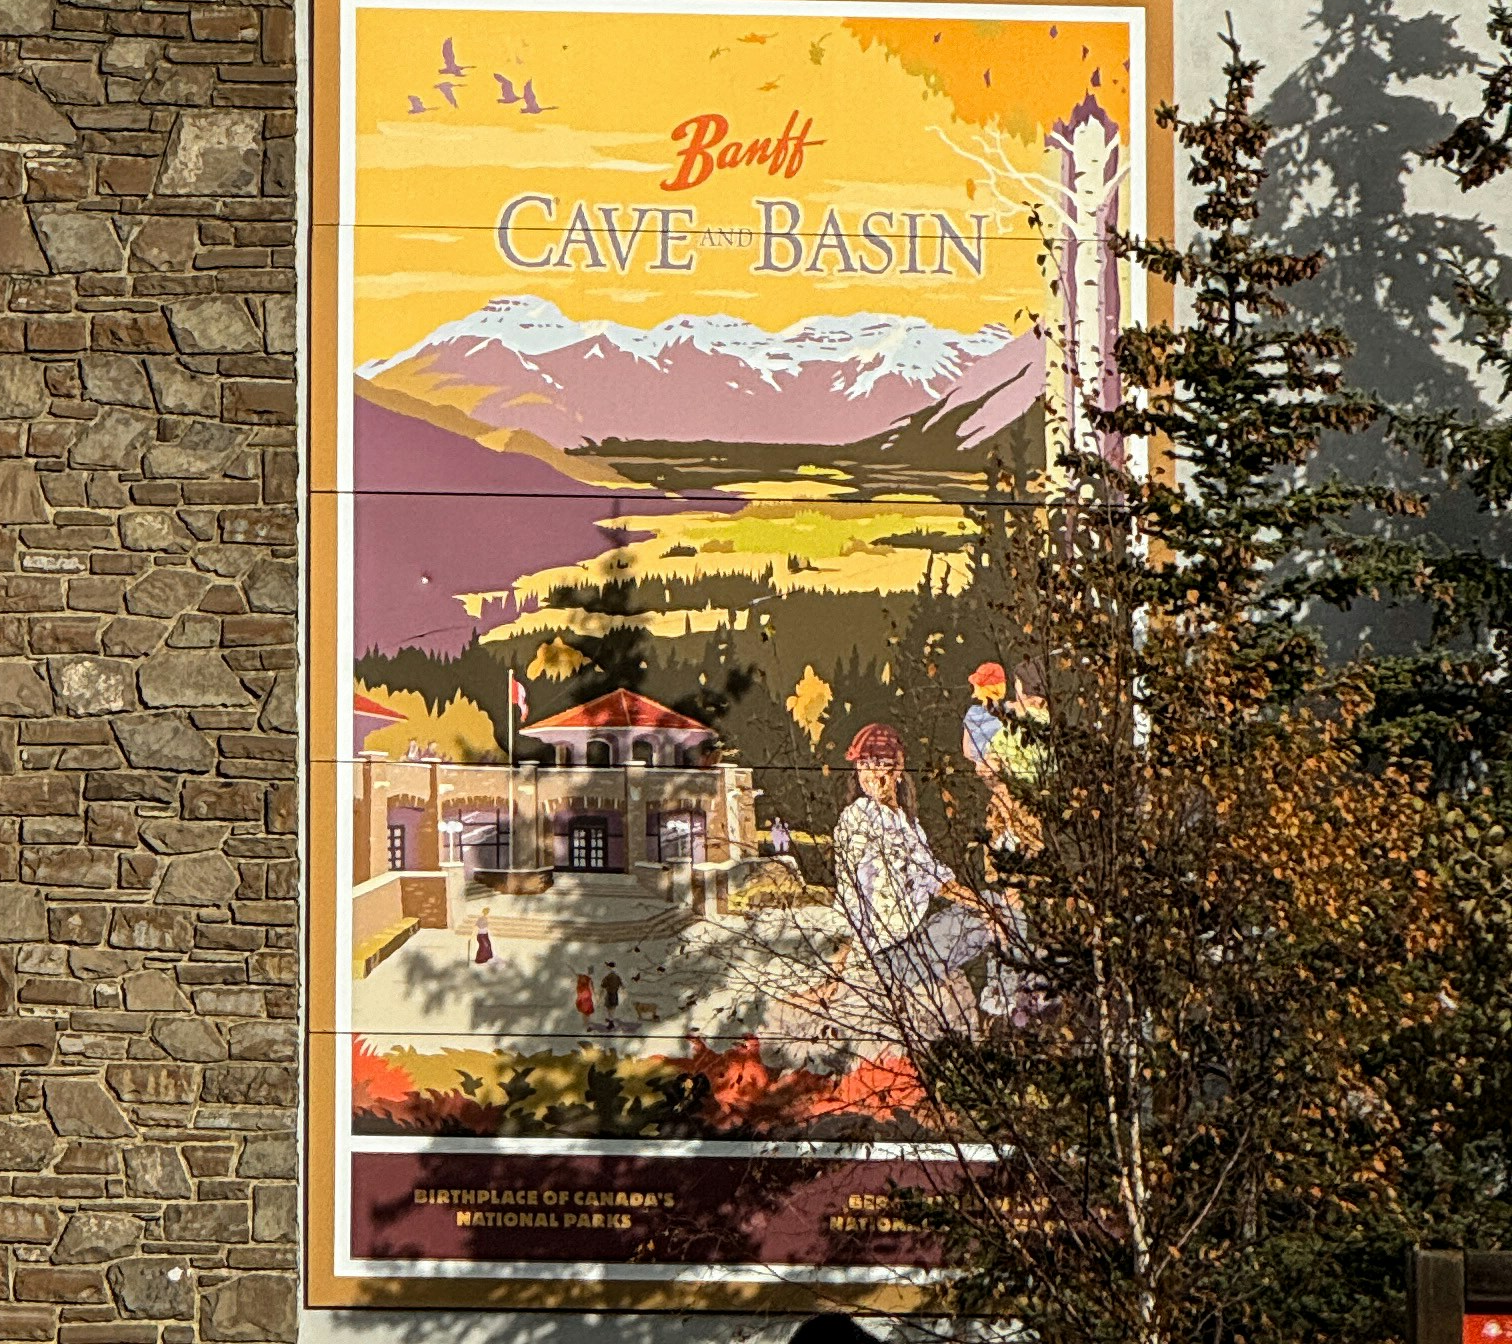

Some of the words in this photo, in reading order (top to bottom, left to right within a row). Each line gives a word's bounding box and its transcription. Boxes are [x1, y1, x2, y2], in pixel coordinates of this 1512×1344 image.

[660, 110, 826, 192] Banff
[498, 196, 693, 271] CAVE
[699, 227, 753, 248] AND
[754, 199, 990, 275] BASIN
[414, 1189, 538, 1205] BIRTHPLACE
[542, 1190, 569, 1206] OF
[573, 1190, 675, 1208] CANADA'S
[456, 1211, 559, 1227] NATIONAL
[564, 1213, 632, 1229] PARKS
